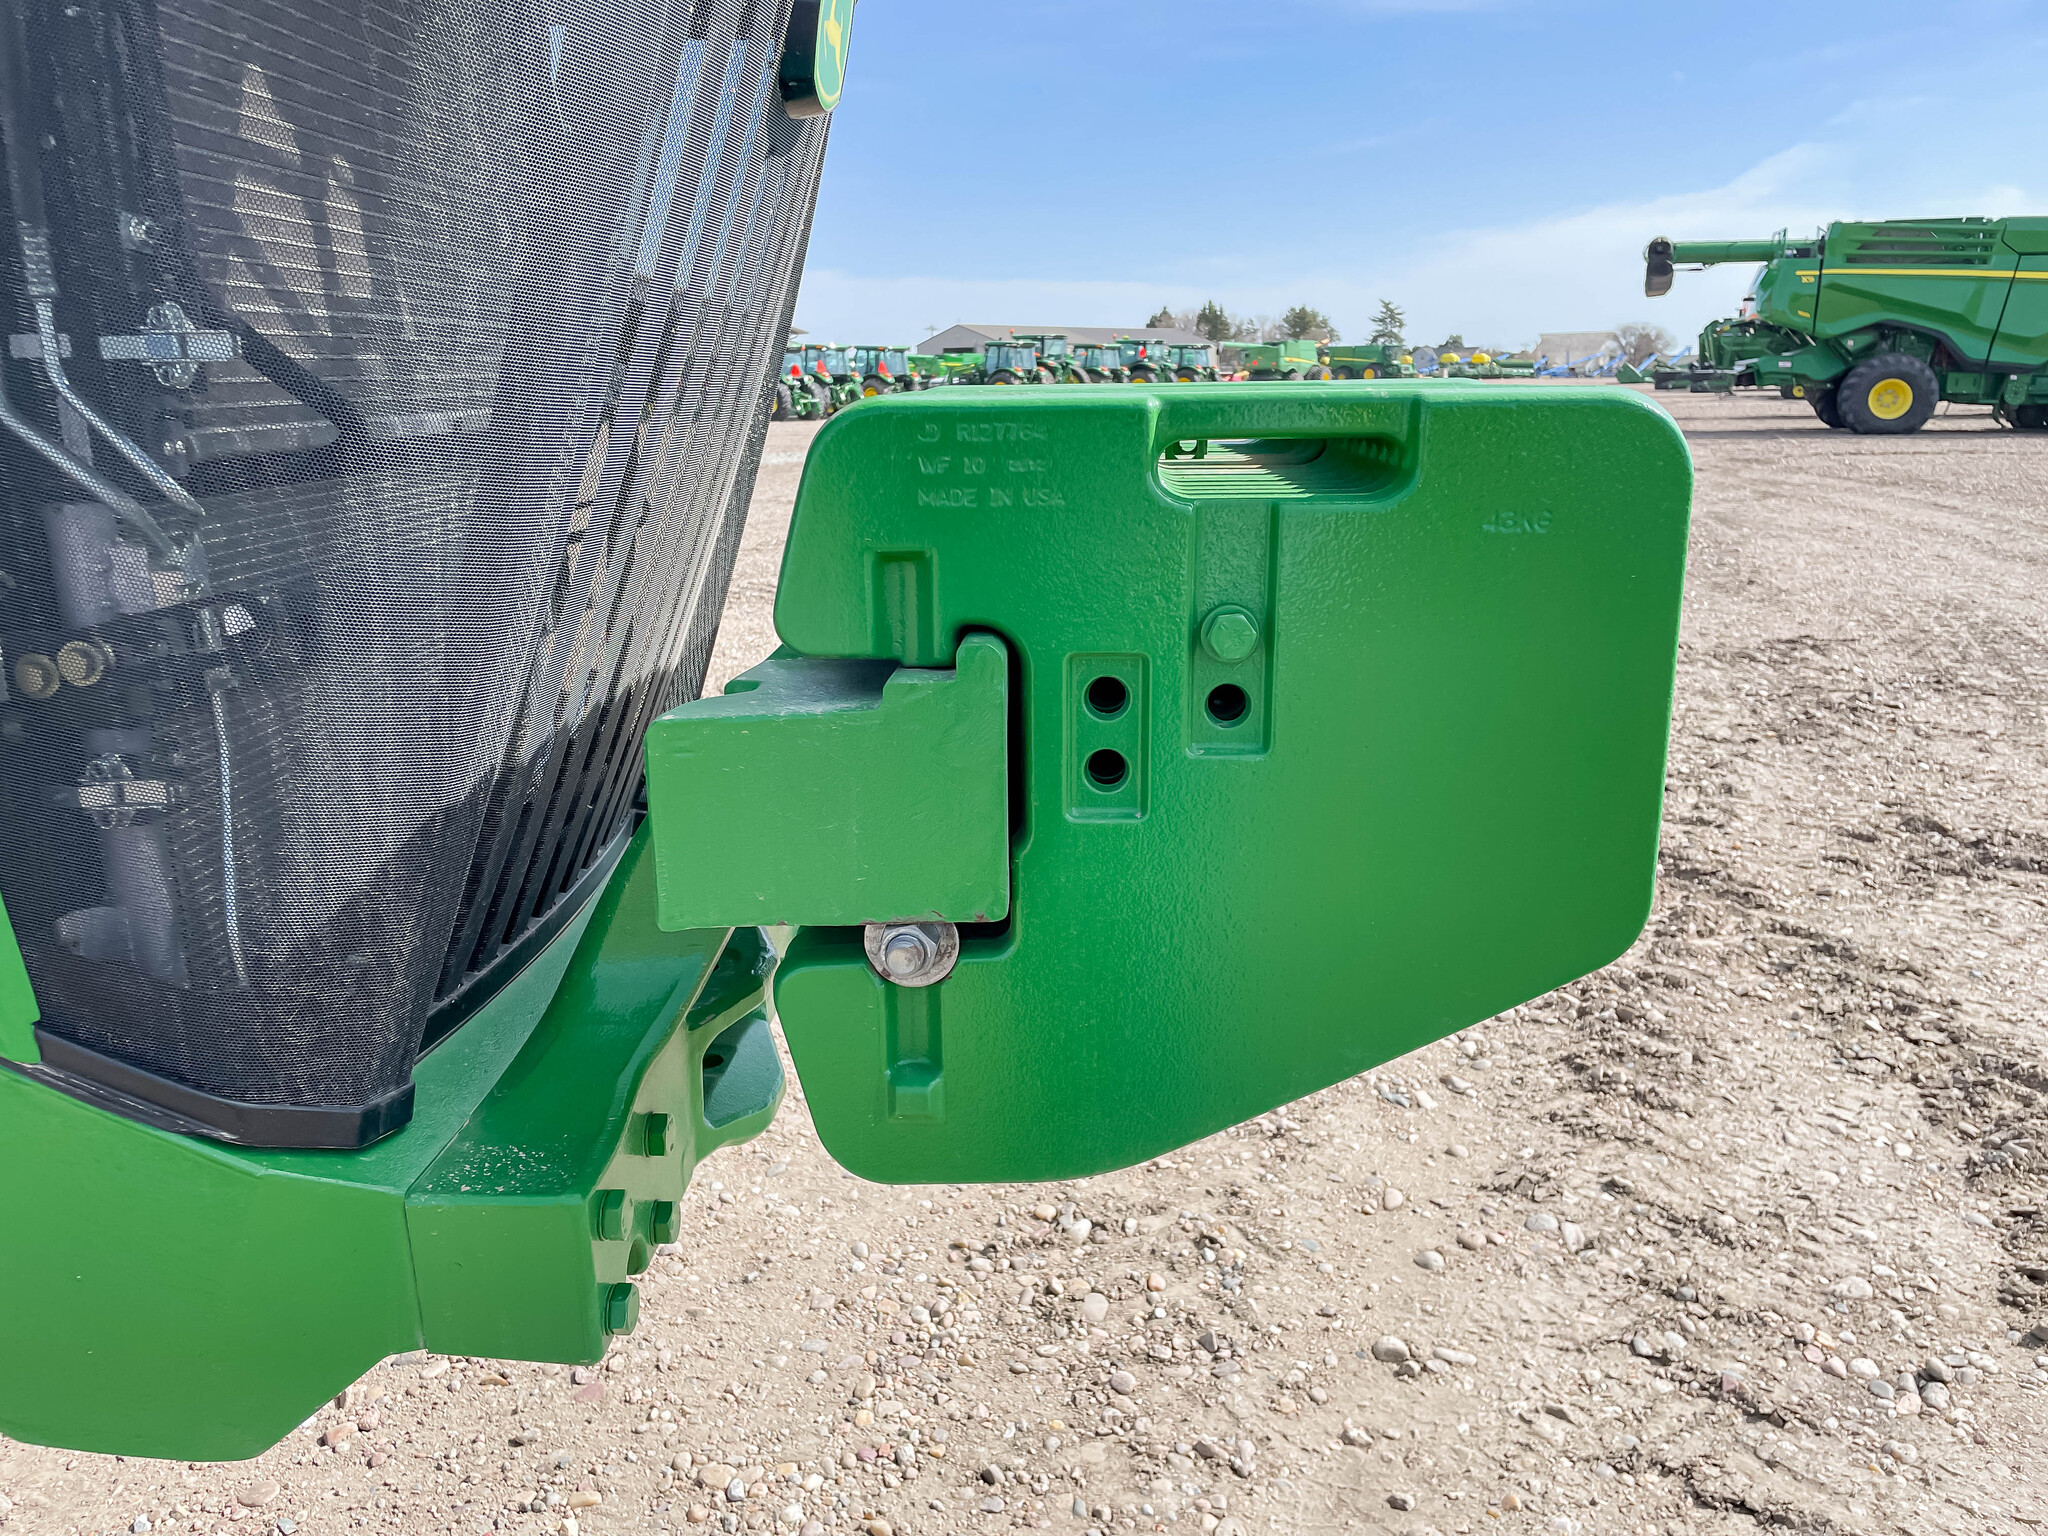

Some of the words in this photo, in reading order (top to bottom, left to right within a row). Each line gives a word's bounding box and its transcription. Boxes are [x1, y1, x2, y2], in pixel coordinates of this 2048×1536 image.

[917, 456, 951, 474] WF
[917, 487, 978, 507] MADE
[989, 487, 1014, 507] IN
[1022, 487, 1067, 507] USA
